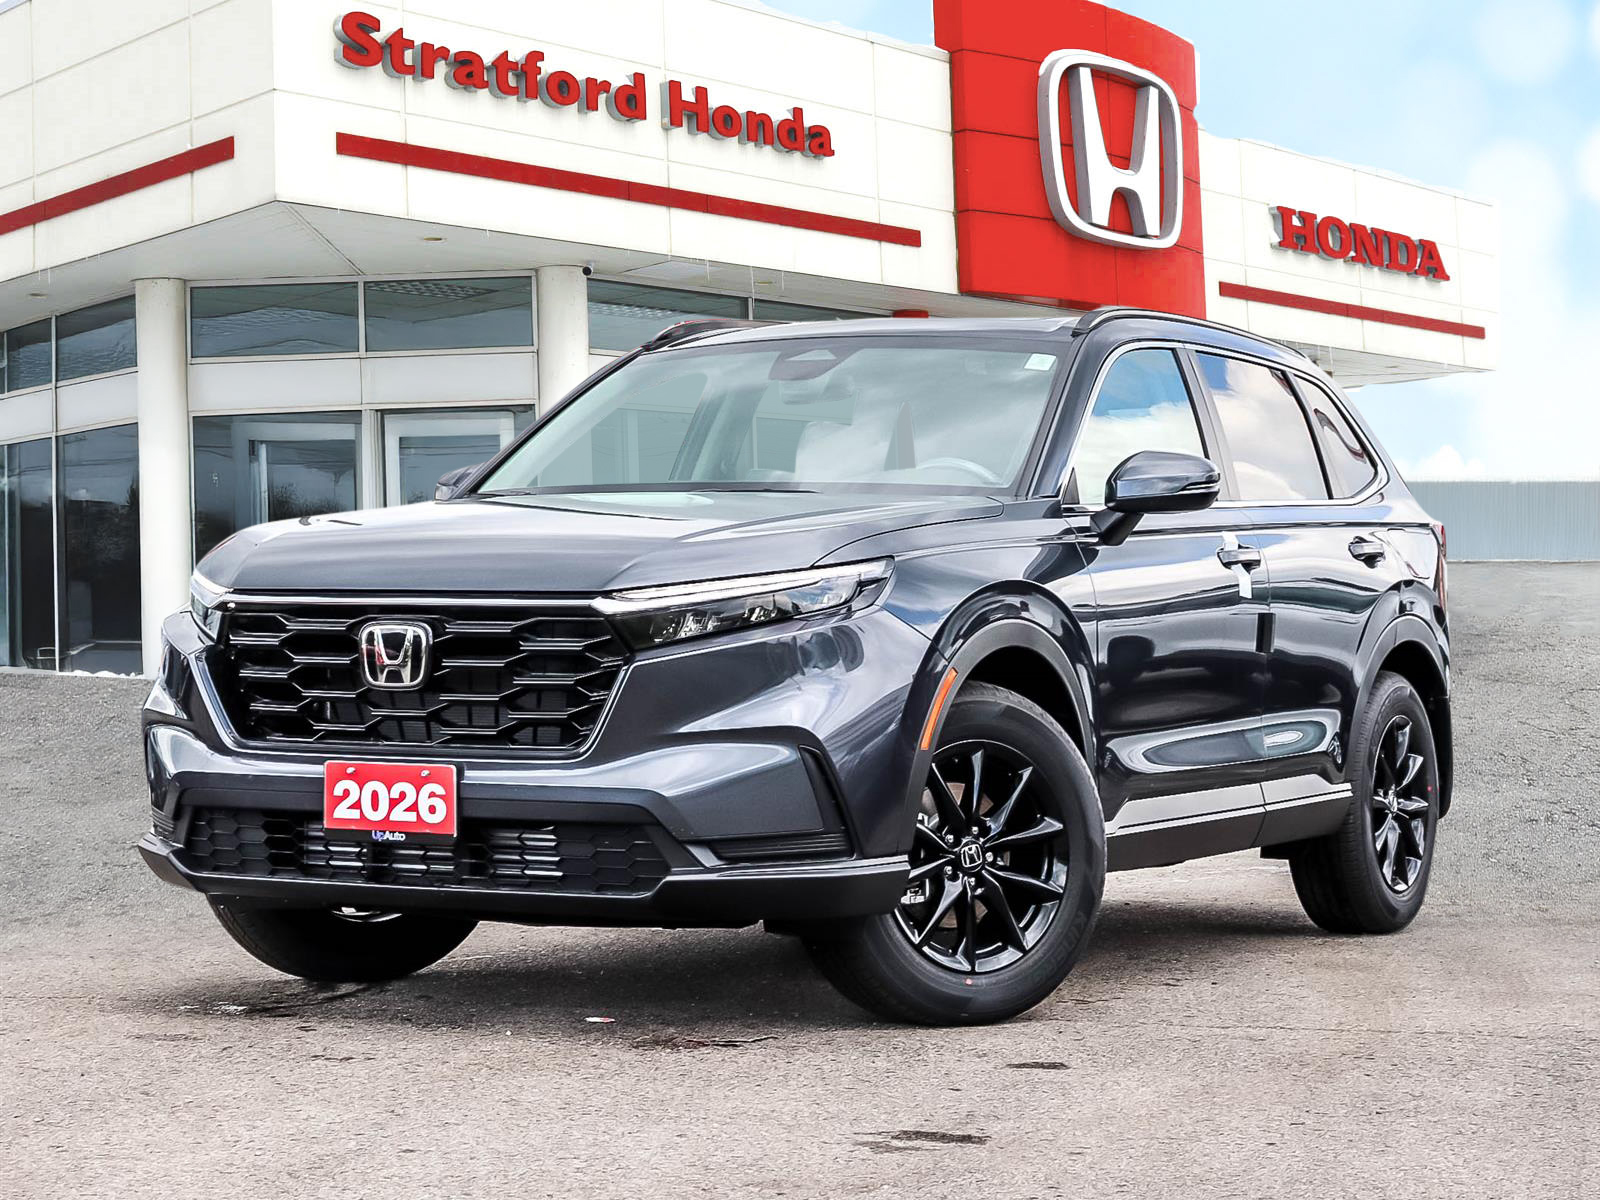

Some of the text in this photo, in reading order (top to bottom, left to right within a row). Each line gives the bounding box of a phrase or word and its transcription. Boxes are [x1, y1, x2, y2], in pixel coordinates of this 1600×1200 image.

[337, 11, 835, 158] Stratford Honda
[1271, 205, 1450, 281] HONDA
[332, 779, 447, 824] 2026
